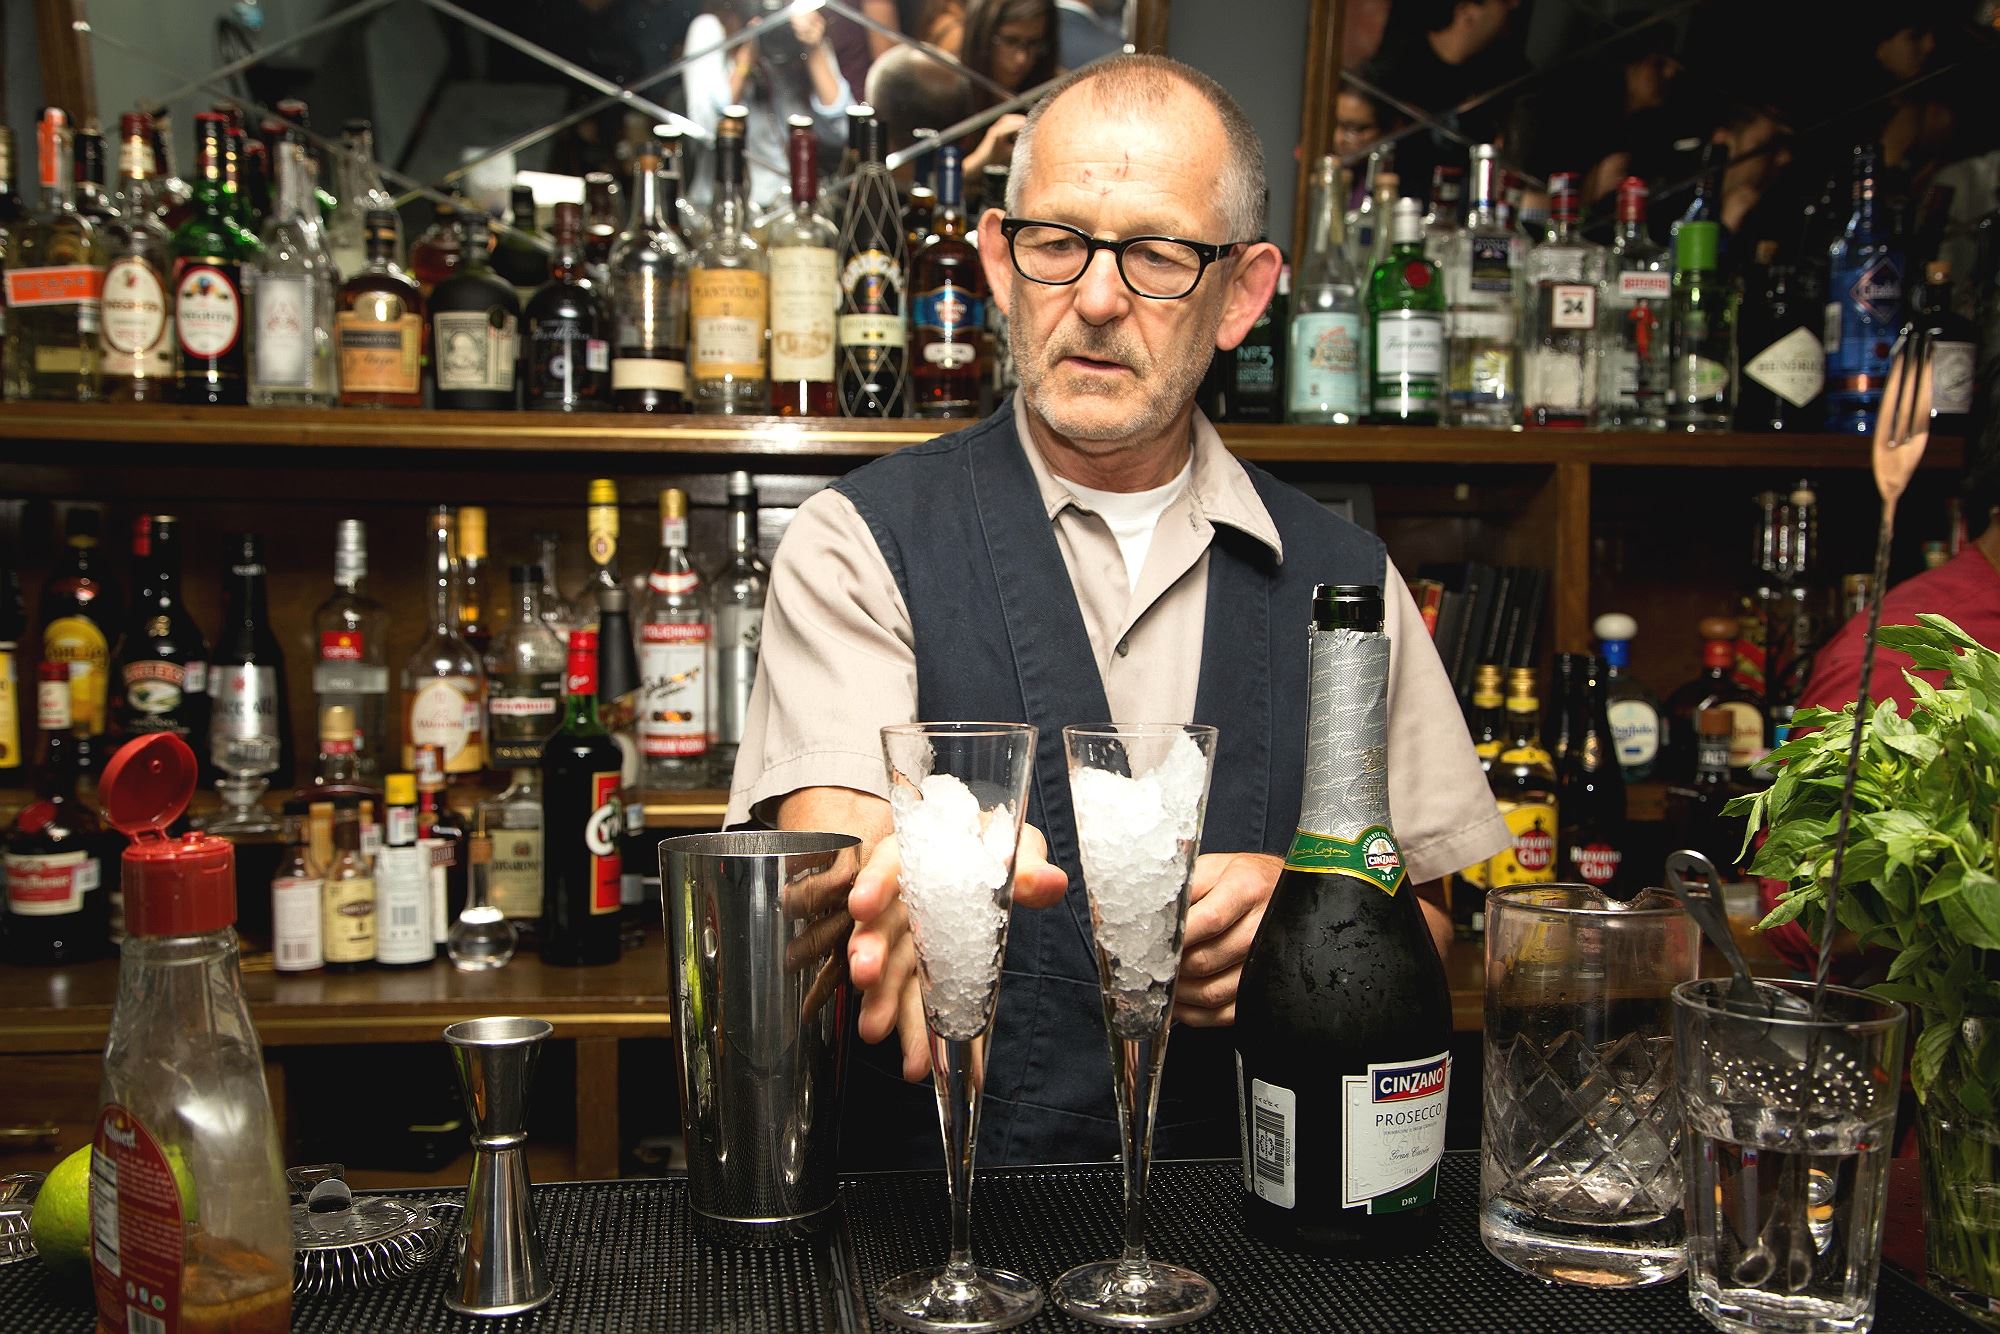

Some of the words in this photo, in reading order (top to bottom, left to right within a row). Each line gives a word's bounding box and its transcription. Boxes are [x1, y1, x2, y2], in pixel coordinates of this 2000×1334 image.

[1563, 298, 1584, 314] 24
[1368, 854, 1398, 866] CINZANO
[1518, 848, 1550, 866] Club
[1581, 861, 1614, 879] Club
[1379, 1067, 1444, 1095] CINZANO
[1375, 1102, 1442, 1127] PROSECCO
[1401, 1196, 1418, 1207] DRY
